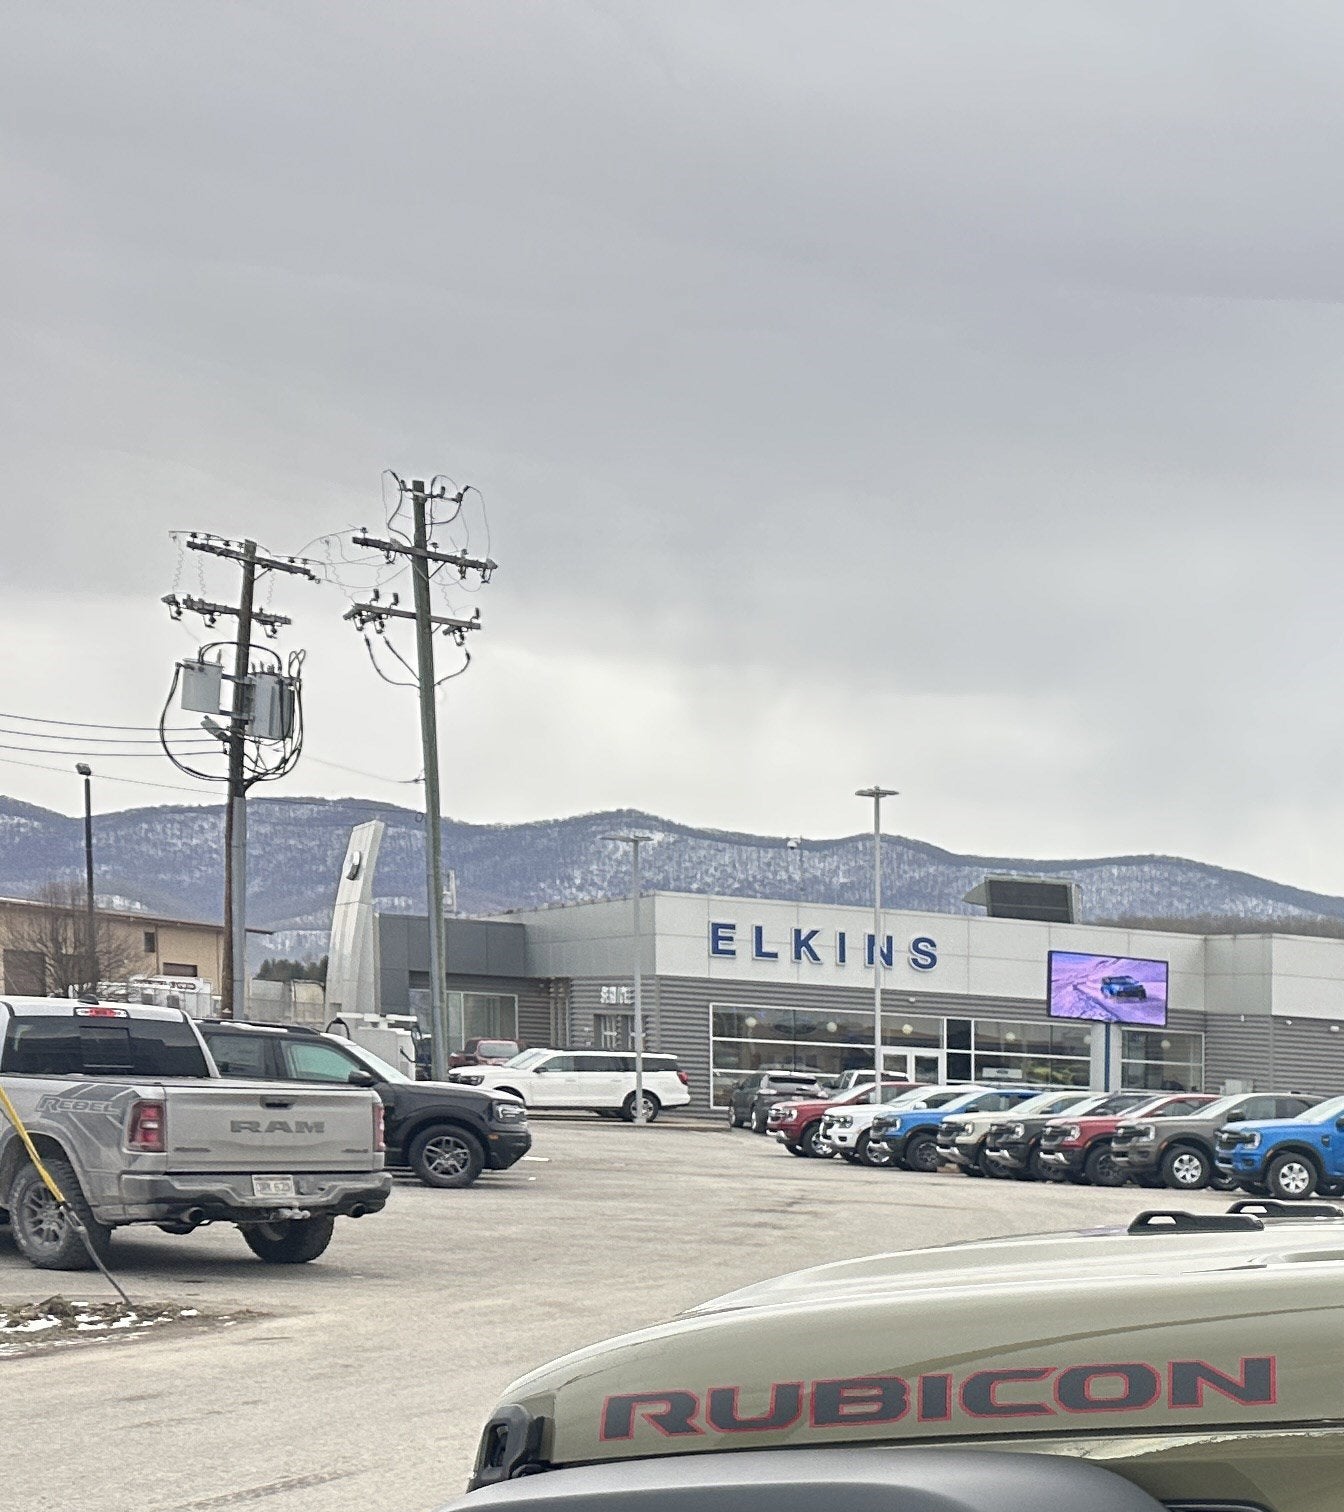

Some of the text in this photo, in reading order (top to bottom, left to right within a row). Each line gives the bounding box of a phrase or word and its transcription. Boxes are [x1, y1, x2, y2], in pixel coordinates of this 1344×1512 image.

[709, 921, 939, 972] ELKINS
[35, 1094, 122, 1114] REBEL
[230, 1119, 326, 1133] RAM
[600, 1356, 1277, 1441] RUBICON
